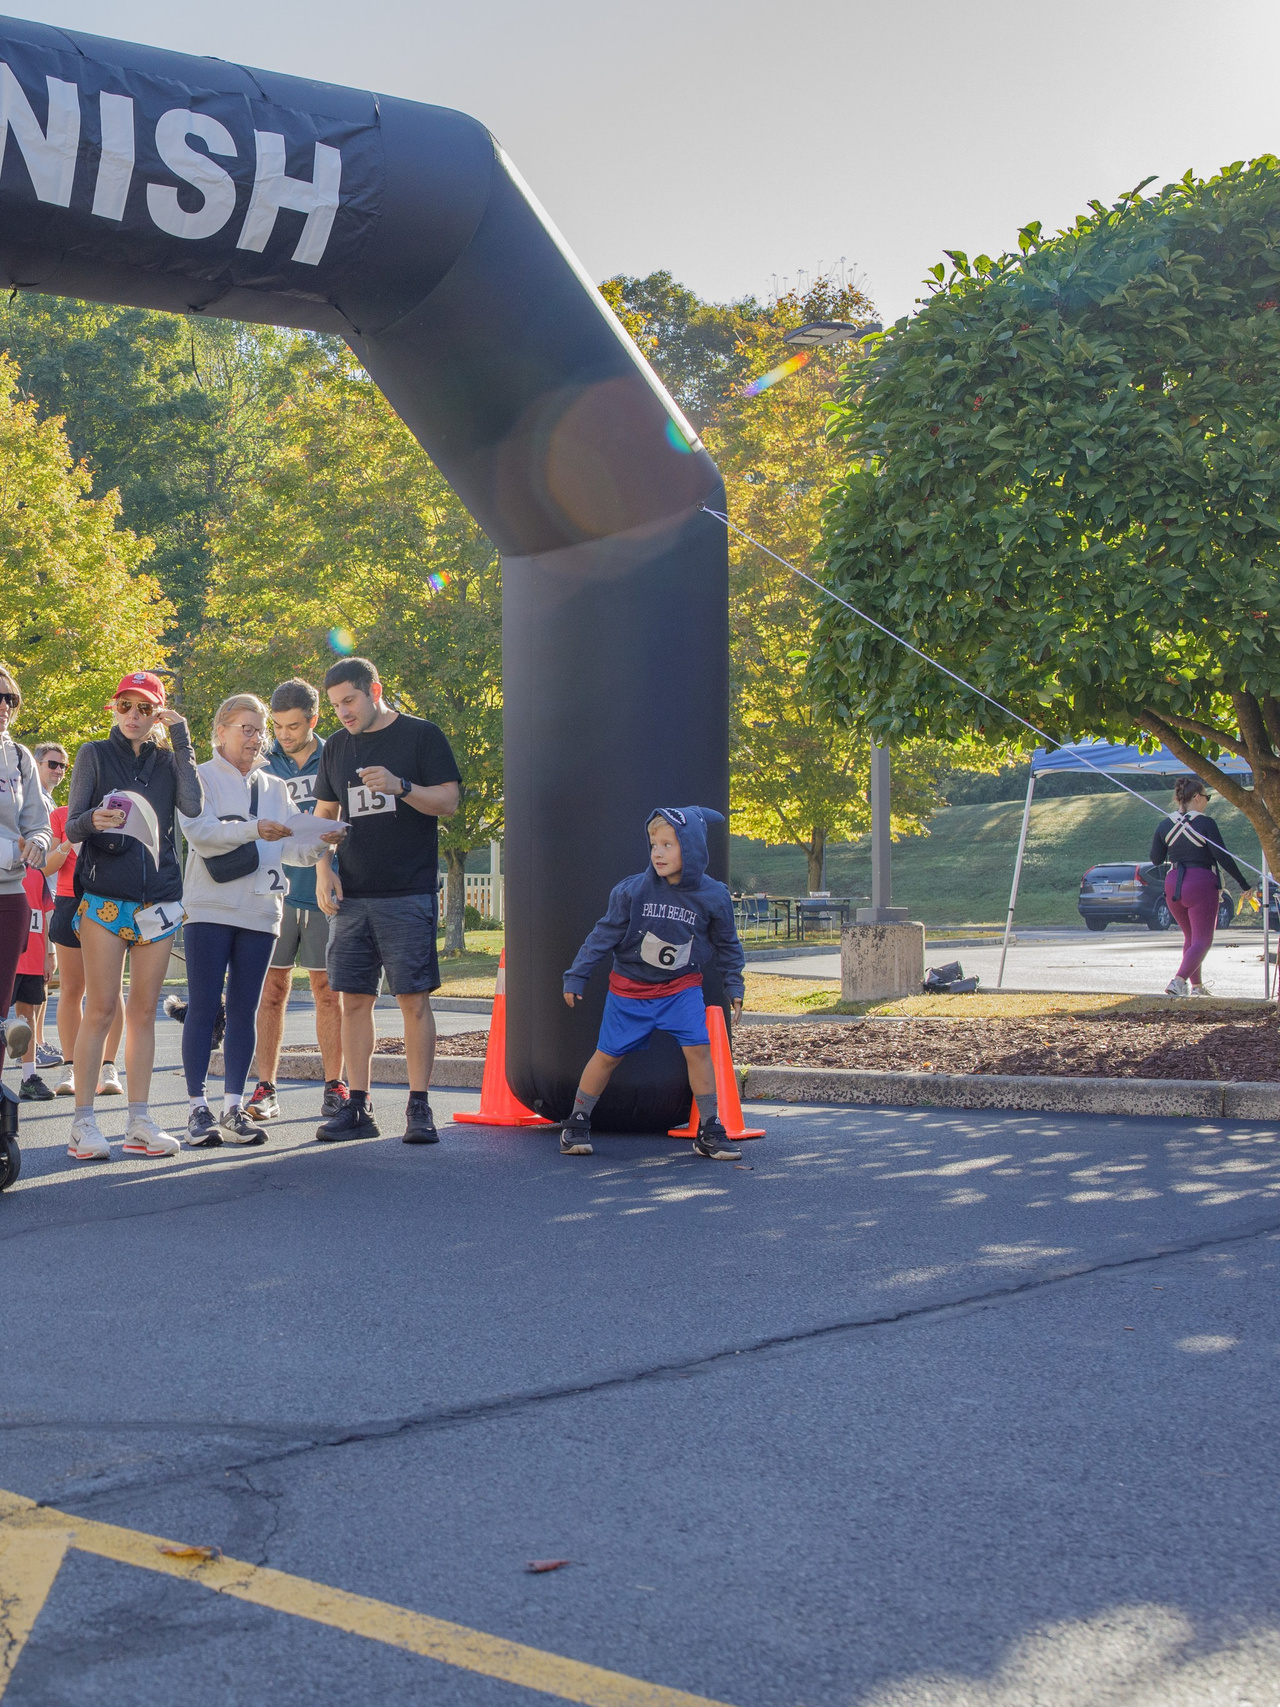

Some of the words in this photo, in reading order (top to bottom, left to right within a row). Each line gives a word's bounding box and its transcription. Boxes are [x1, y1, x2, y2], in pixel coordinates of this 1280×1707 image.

[287, 778, 314, 801] 21
[357, 789, 386, 813] 15
[267, 869, 284, 891] 2
[31, 912, 39, 930] 1
[154, 906, 174, 931] 1
[641, 903, 667, 918] PALM
[667, 905, 697, 926] BEACH
[658, 946, 678, 966] 6
